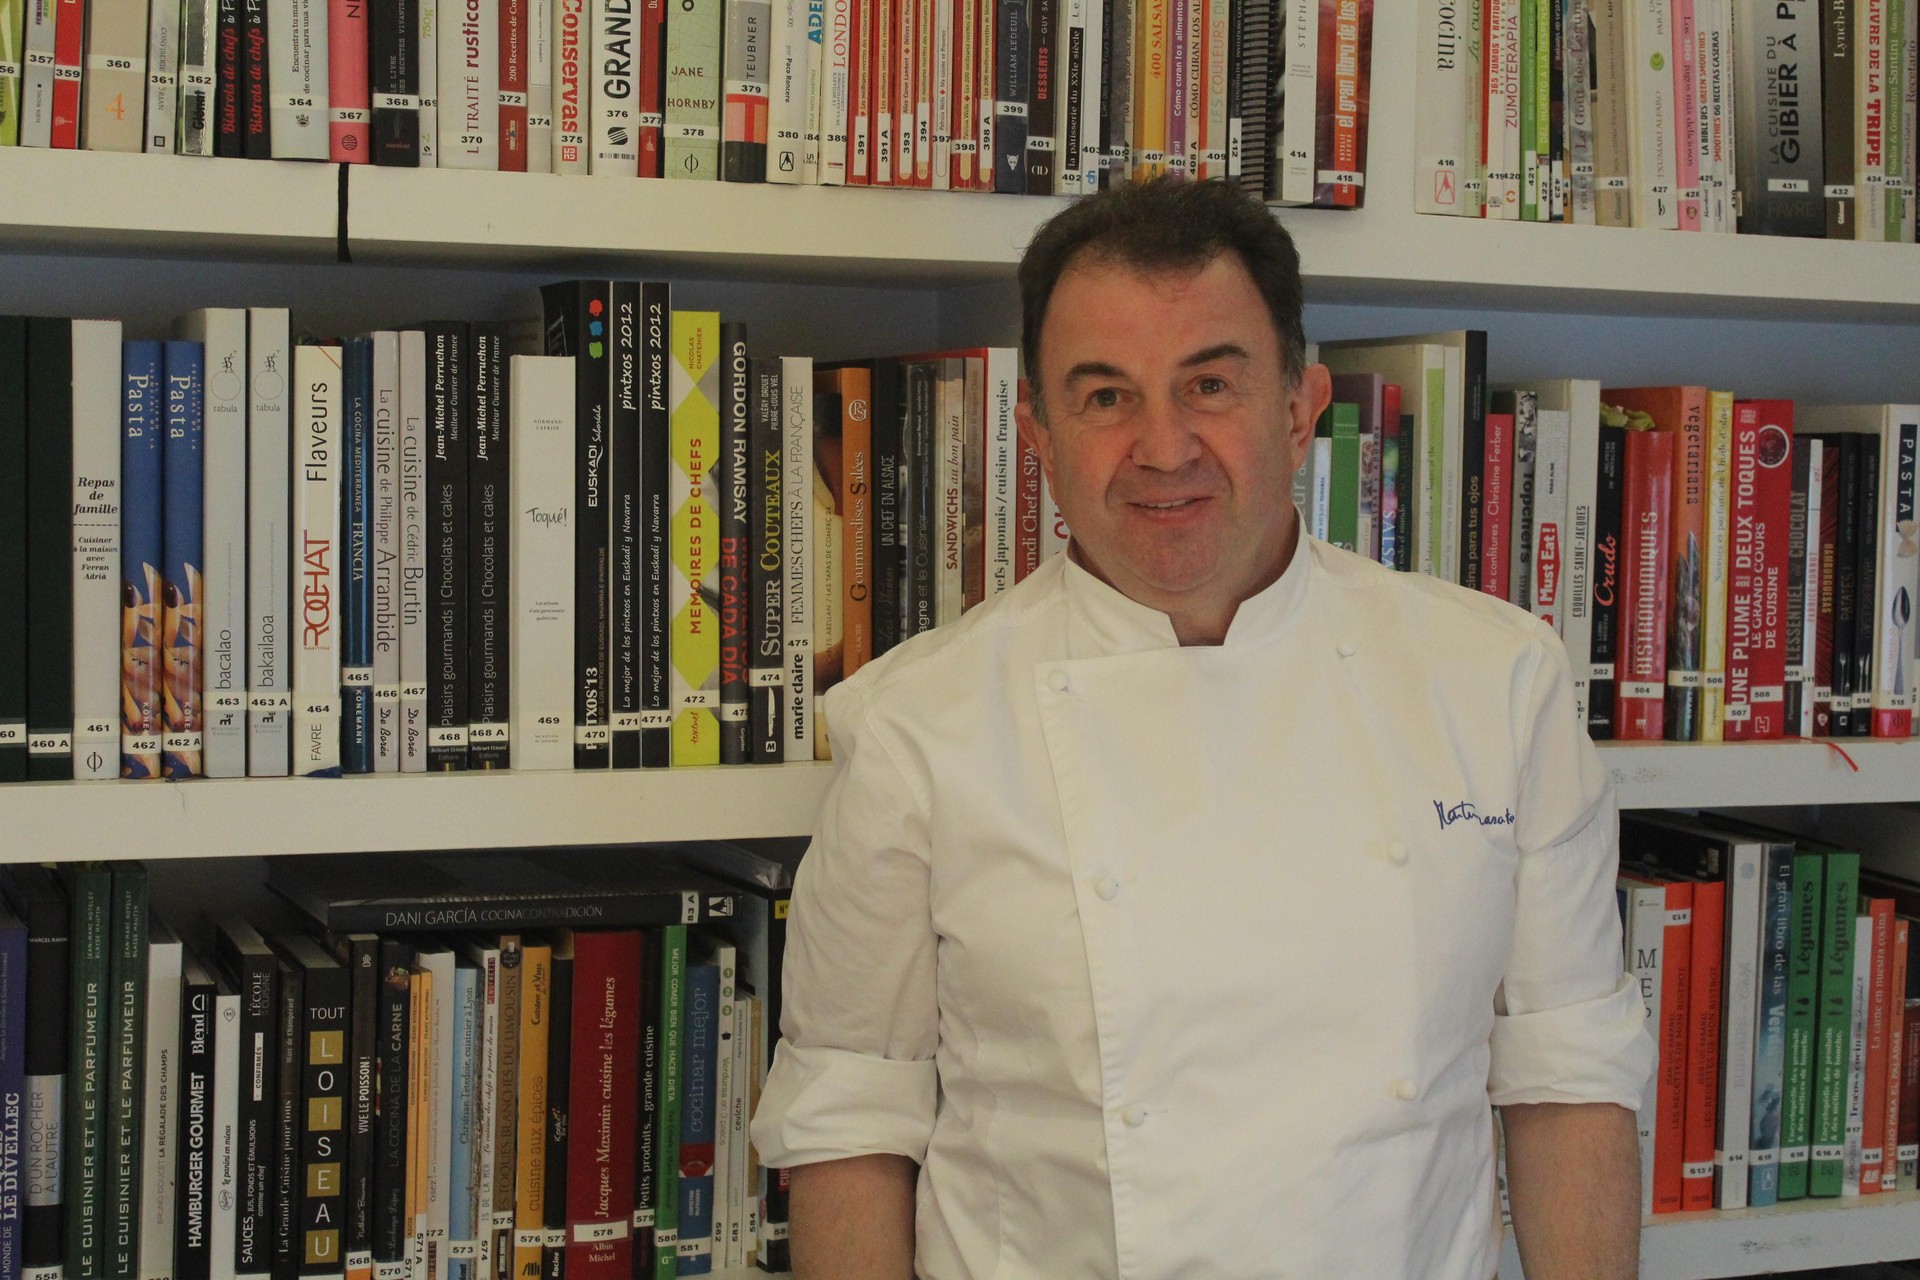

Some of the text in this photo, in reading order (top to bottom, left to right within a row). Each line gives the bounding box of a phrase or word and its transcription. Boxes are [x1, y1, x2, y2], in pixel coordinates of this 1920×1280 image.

[746, 16, 757, 78] TEUBNER
[785, 58, 793, 73] Paco
[1010, 9, 1018, 51] LEDEUIL
[56, 69, 80, 78] 359
[188, 75, 212, 85] 362
[223, 28, 238, 134] Bistrots de chefs
[289, 98, 312, 107] 364
[386, 98, 409, 106] 368
[671, 66, 704, 77] JANE
[1038, 48, 1048, 100] DESSERTS
[1337, 22, 1356, 112] gran libro de
[1505, 15, 1518, 128] ZUMOTERAPIA
[1767, 36, 1779, 165] LA CUISINE DU
[1778, 33, 1800, 164] GIBIER À
[464, 75, 479, 132] TRAITÉ
[667, 98, 715, 110] HORNBY
[683, 128, 704, 136] 378
[778, 131, 799, 139] 380
[1866, 50, 1881, 166] DE LA TRIPE
[461, 136, 483, 144] 370
[1702, 146, 1709, 156] LA
[1337, 174, 1353, 182] 415
[619, 302, 637, 410] pintxos 2012
[128, 374, 148, 438] Pasta
[304, 382, 328, 482] Flaveurs
[435, 335, 447, 460] Jean-Michel Perruchon
[733, 341, 747, 523] GORDON RAMSAY
[790, 385, 805, 464] FRANÇAISE
[78, 477, 115, 489] Repas
[89, 491, 104, 501] de
[588, 445, 597, 507] EUSKADI
[995, 379, 1009, 566] japonais cuisine française
[1488, 425, 1501, 577] confitures Christine Ferber
[1899, 439, 1914, 513] PASTA
[74, 504, 118, 516] famille
[377, 389, 397, 652] La cuisine de Philippe Arrambide
[690, 438, 702, 635] MEMOIRES DE CHEFS
[850, 452, 867, 602] Gourmandises Salées
[947, 488, 959, 570] SANDWICHS
[81, 564, 109, 572] Ferran
[303, 529, 330, 646] ROCHAT
[760, 450, 780, 656] SUPER COUTEAUX
[1539, 525, 1556, 603] Must Eat!
[1572, 505, 1586, 617] COQUILLES SAINT-JACQUES
[1594, 532, 1617, 607] Crudo
[1731, 430, 1756, 706] UNE PLUME DEUX TOQUES
[1752, 522, 1765, 649] LE GRAND COURS
[404, 567, 423, 625] Burtin
[441, 484, 456, 726] Plaisirs gourmands Chocolats et cakes
[721, 537, 738, 684] DE CADA DÍA
[1636, 511, 1658, 675] BISTRONOMIQUES
[1765, 567, 1778, 649] DE CUISINE
[214, 629, 232, 690] bacalao
[257, 614, 275, 687] bakailaoa
[788, 639, 808, 647] 475
[307, 705, 330, 713] 464
[684, 696, 705, 704] 472
[792, 654, 804, 740] marie claire
[133, 741, 156, 750] 462
[311, 723, 322, 760] FAVRE
[385, 909, 477, 927] DANI GARCÍA
[191, 1013, 204, 1055] Blend
[310, 1007, 345, 1020] TOUT
[392, 1003, 403, 1051] CARNE
[689, 987, 709, 1133] cocinar mejor
[82, 983, 97, 1276] LE CUISINIER ET LE PARFUMEUR
[359, 1062, 370, 1134] VIVE LE POISSON
[594, 976, 617, 1218] Jacques Maximin cuisine les légumes
[639, 1025, 655, 1209] Petits produits... grande cuisine
[188, 1072, 205, 1248] HAMBURGER GOURMET
[529, 1128, 541, 1212] cuisine aux
[349, 1257, 370, 1265] 568
[589, 1253, 616, 1262] Michel
[591, 1243, 614, 1251] Albin
